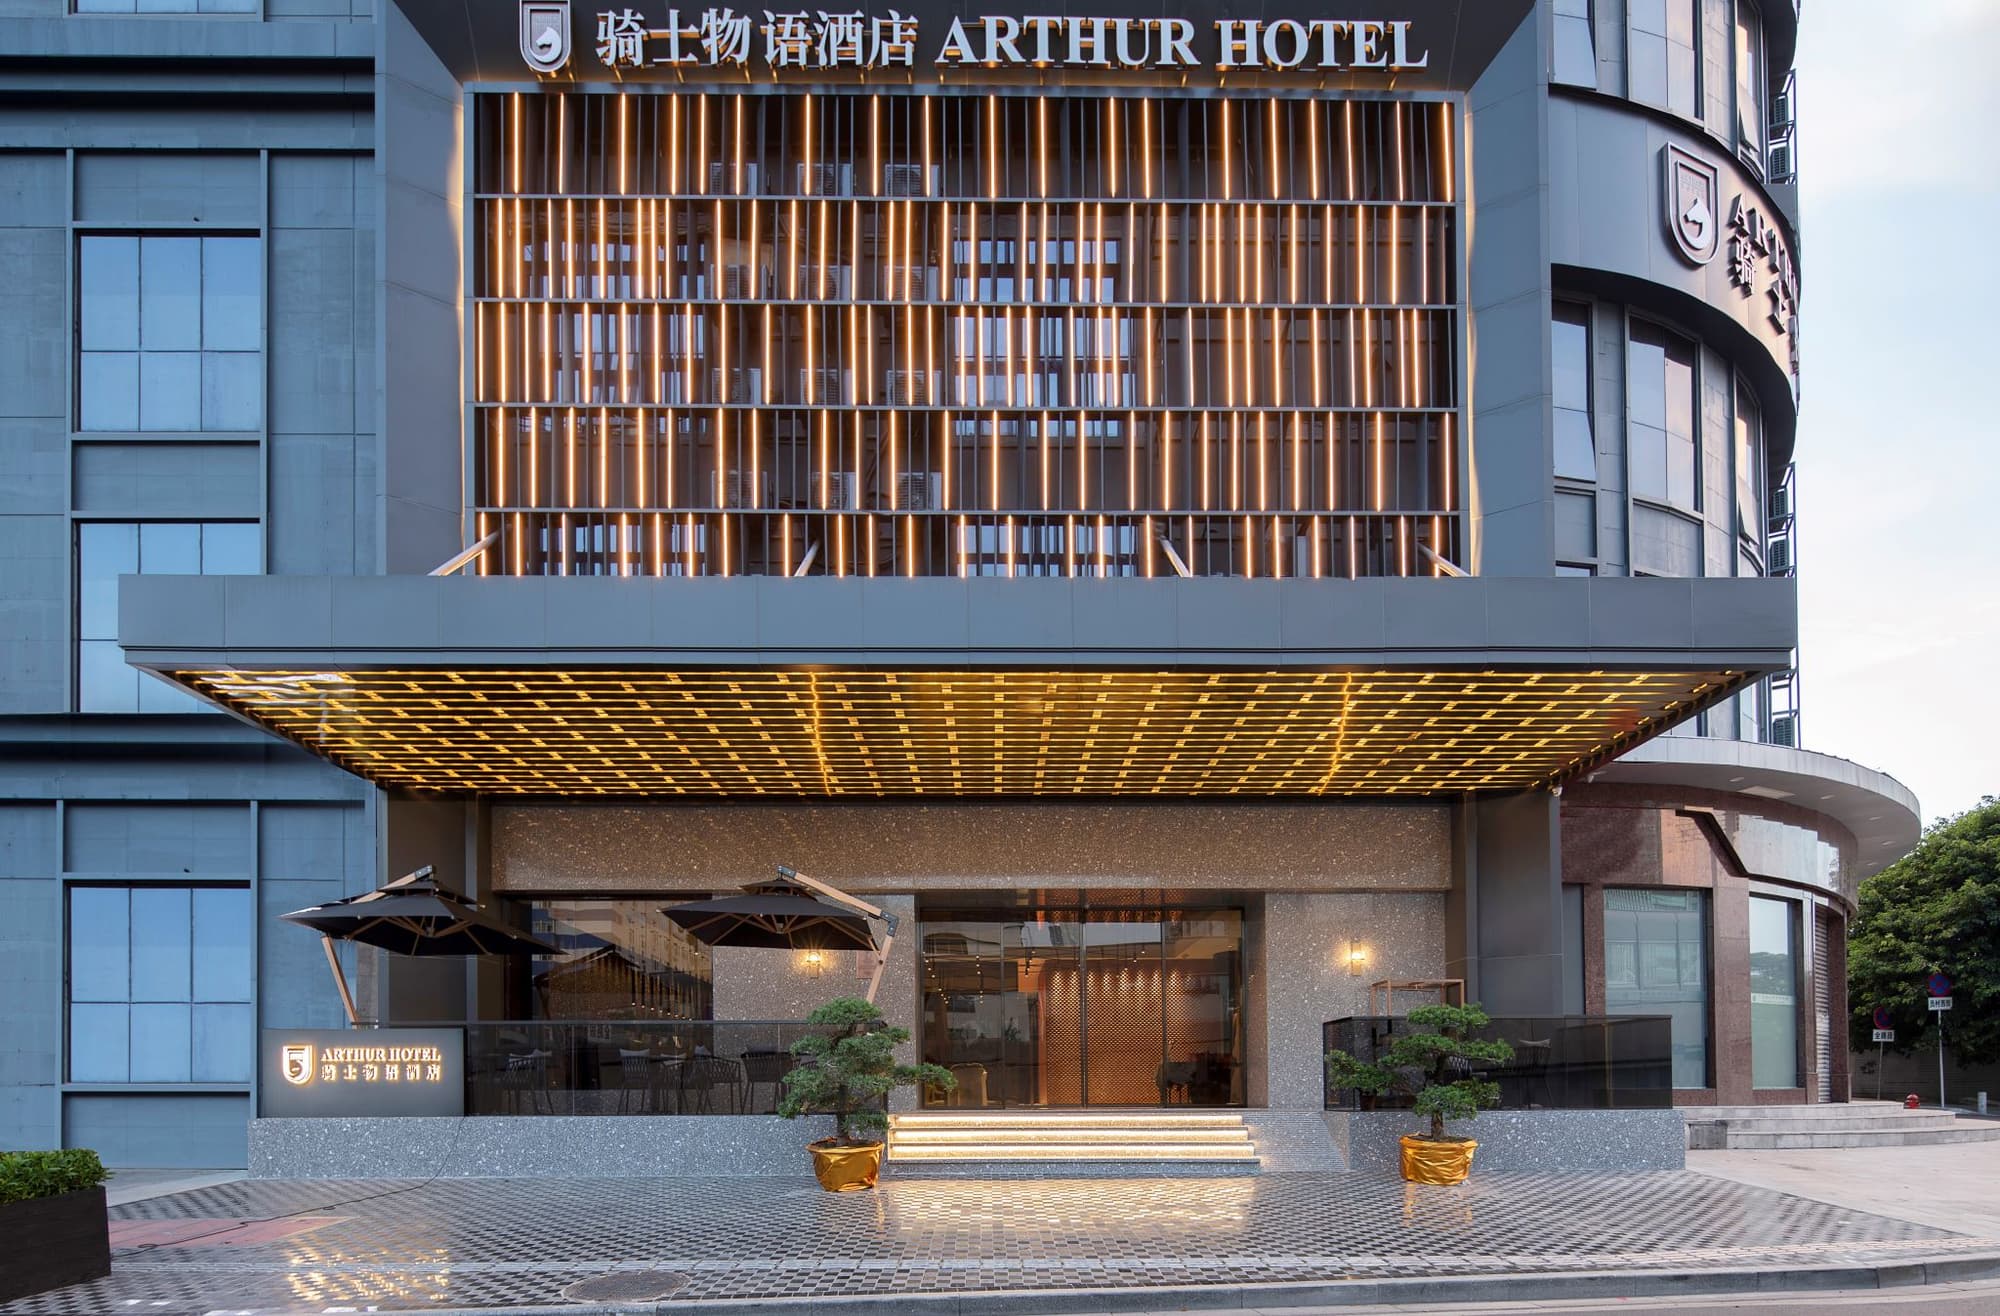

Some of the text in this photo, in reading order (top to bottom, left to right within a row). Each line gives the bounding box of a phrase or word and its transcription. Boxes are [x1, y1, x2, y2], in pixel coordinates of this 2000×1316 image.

[596, 8, 918, 67] 骑士物语酒店
[935, 15, 1428, 68] ARTHUR HOTEL
[321, 1047, 442, 1062] ARTHUR HOTEL
